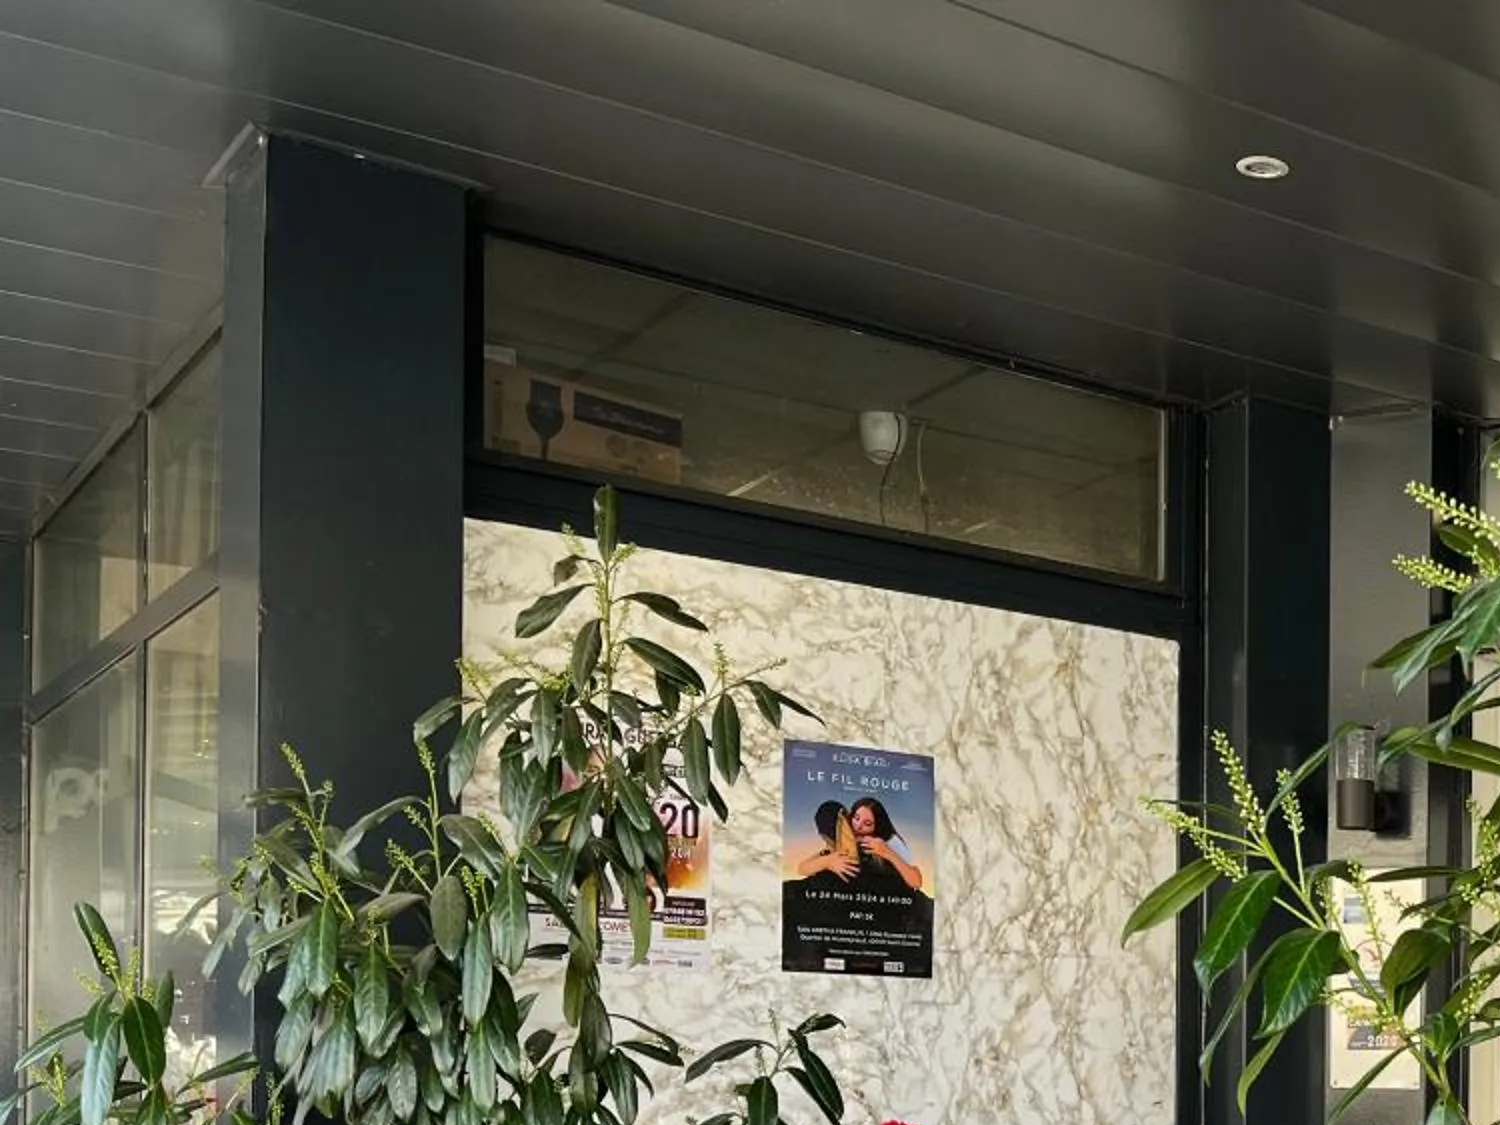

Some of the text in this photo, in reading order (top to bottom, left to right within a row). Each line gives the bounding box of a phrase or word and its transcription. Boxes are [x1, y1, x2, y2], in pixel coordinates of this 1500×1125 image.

[807, 770, 826, 782] LE
[831, 773, 853, 785] FIL
[861, 775, 909, 791] ROUGE
